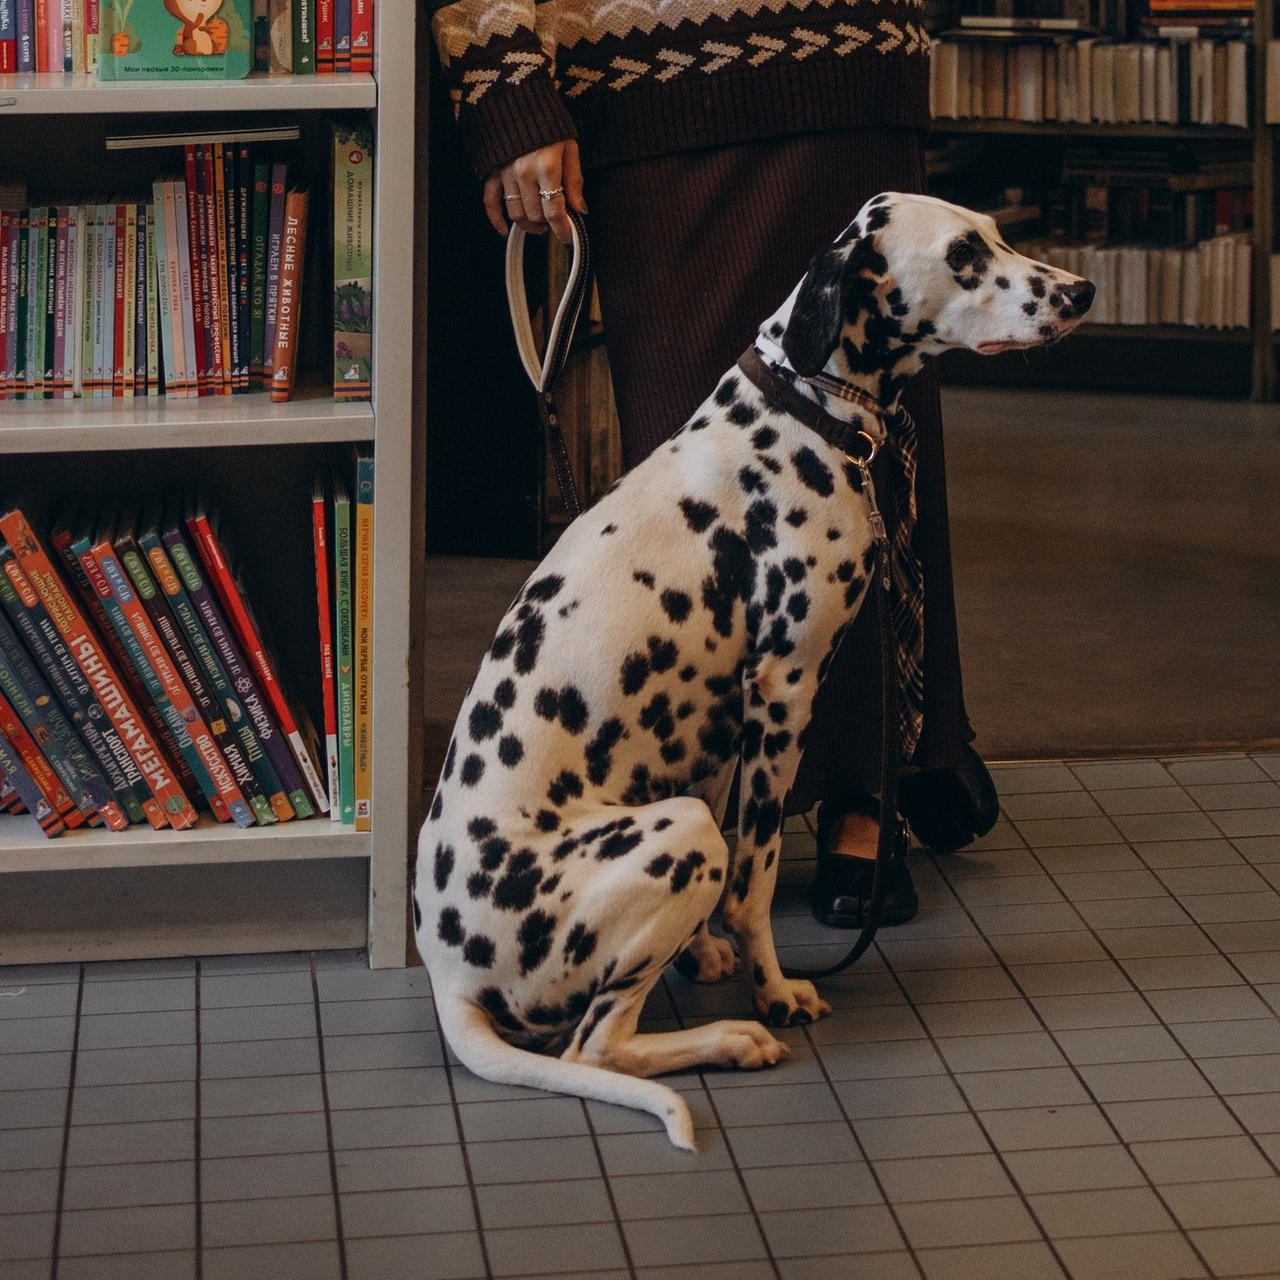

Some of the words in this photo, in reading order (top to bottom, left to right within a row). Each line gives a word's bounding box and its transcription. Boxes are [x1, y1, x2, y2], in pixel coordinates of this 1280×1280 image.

[124, 65, 138, 73] Мои
[140, 66, 168, 74] первые
[169, 65, 225, 74] 3D-панорамки
[270, 233, 280, 271] ИГРАЕМ
[285, 215, 298, 270] ЛЕСНЫЕ
[268, 284, 277, 324] ПРЯТКИ!
[279, 278, 293, 349] ЖИВОТНЫЕ
[340, 527, 348, 566] БОЛЬШАЯ
[42, 572, 76, 620] ПАНОРАМЫ
[342, 609, 350, 656] ОКОШКАМИ
[70, 633, 171, 790] МЕГАМАШИНЫ
[243, 694, 272, 740] ФИЗИКА
[342, 683, 351, 748] ДИНОЗАВРЫ
[82, 721, 129, 791] АРХИТЕКТУРА
[102, 729, 136, 787] ТРАНСПОРТ
[195, 733, 235, 795] ИСКУССТВО
[224, 743, 255, 787] ХИМИЯ
[237, 725, 264, 762] ПТИЦЫ
